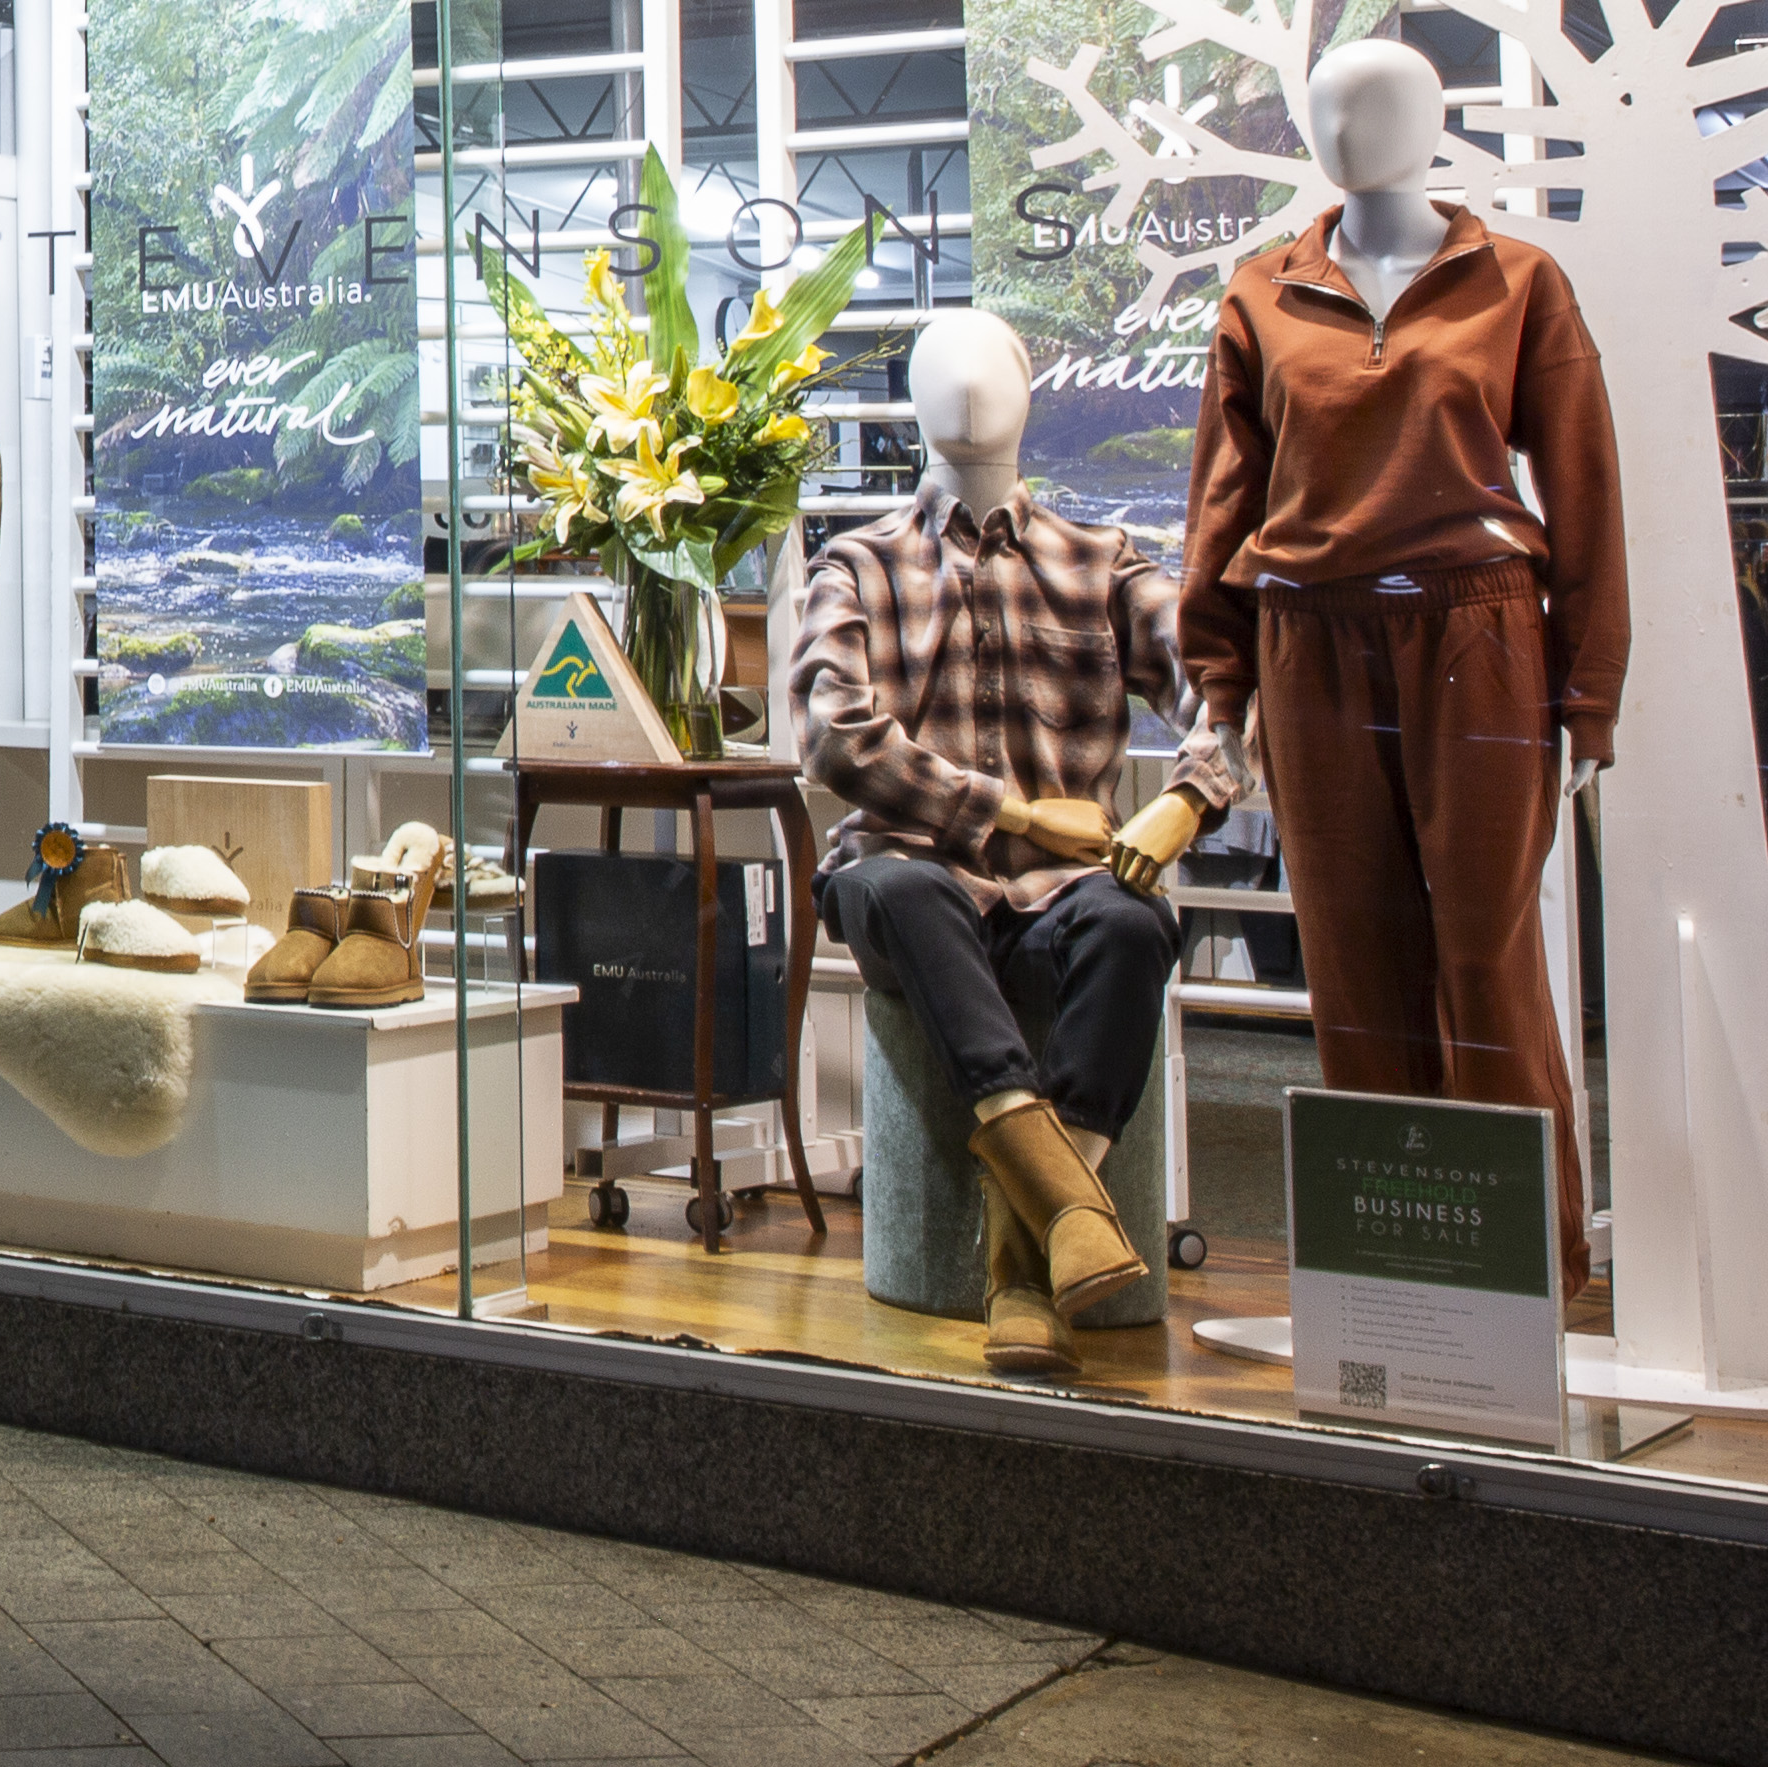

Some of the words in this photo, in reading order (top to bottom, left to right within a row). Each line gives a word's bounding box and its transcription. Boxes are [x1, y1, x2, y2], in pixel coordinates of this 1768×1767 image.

[203, 349, 317, 389] ever
[526, 699, 586, 711] AUSTRALIAN
[588, 701, 618, 712] MADE
[593, 963, 624, 979] EMU
[1336, 1157, 1499, 1187] STEVENSONS
[1362, 1176, 1478, 1205] FREEHOLD
[1353, 1195, 1483, 1227] BUSINESS
[1356, 1218, 1403, 1238] FOR
[1421, 1224, 1482, 1248] SALE
